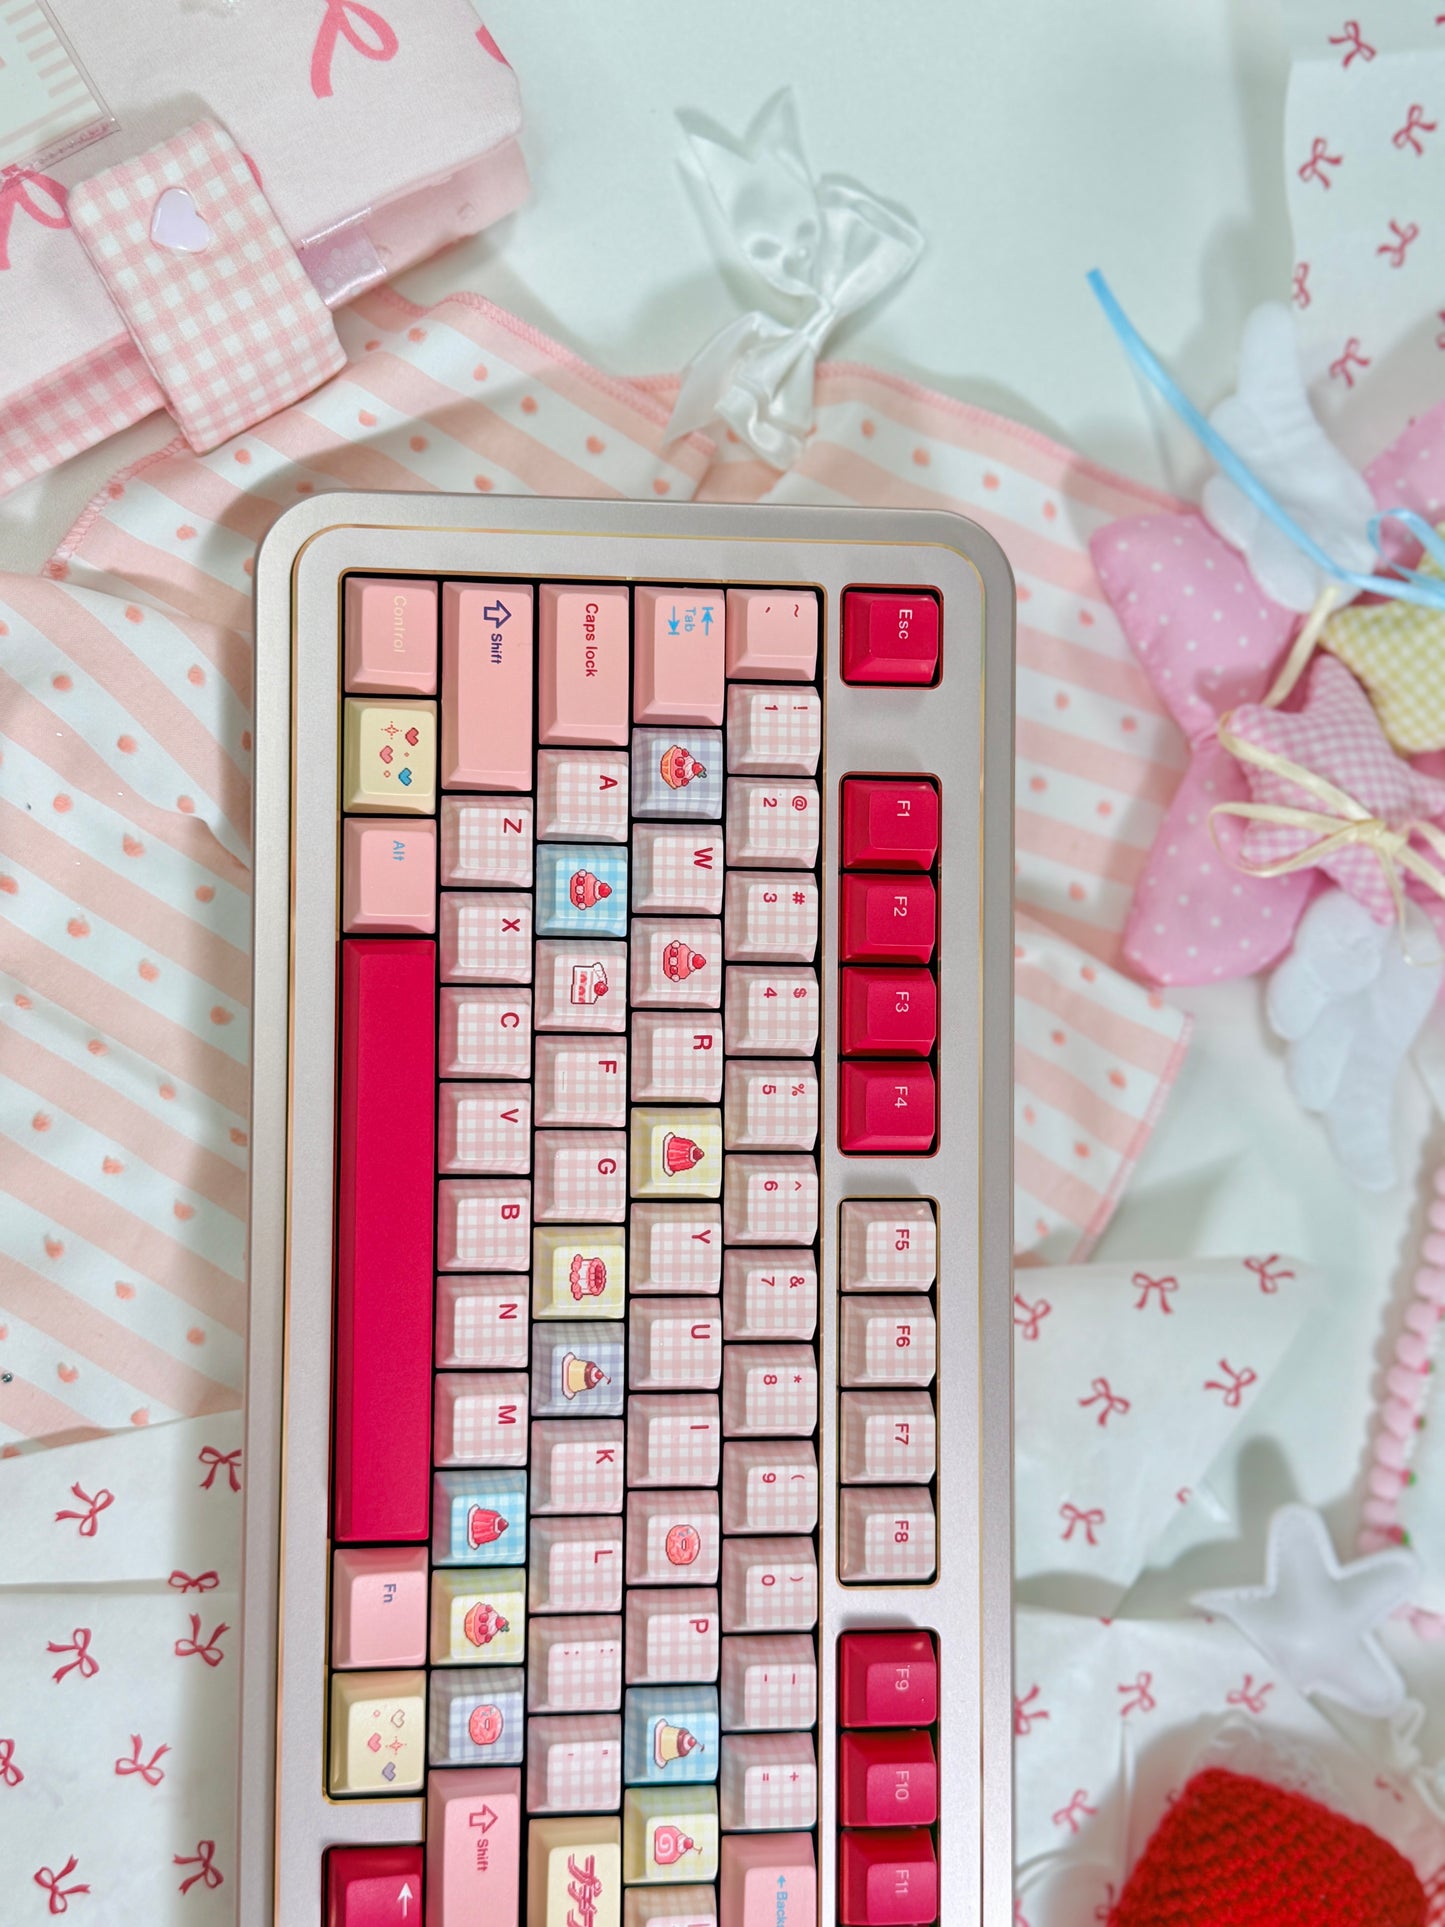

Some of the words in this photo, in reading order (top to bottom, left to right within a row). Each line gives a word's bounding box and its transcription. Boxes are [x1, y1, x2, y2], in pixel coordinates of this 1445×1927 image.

[393, 595, 408, 654] Control
[584, 602, 599, 642] Caps
[683, 606, 697, 633] Tab
[898, 609, 913, 640] Esc
[490, 633, 503, 665] Shift
[585, 646, 599, 677] lock
[599, 774, 619, 791] A
[763, 797, 778, 808] 2
[791, 795, 808, 812] @
[896, 800, 911, 817] F1
[503, 817, 523, 834] Z
[392, 839, 406, 862] Alt
[693, 846, 714, 870] W
[762, 892, 778, 904] 3
[792, 891, 806, 906] #
[893, 896, 908, 917] F2
[501, 918, 521, 933] X
[763, 986, 778, 999] 4
[792, 987, 808, 999] $
[895, 991, 910, 1013] F3
[500, 1011, 520, 1029] C
[692, 1034, 713, 1051] R
[597, 1060, 618, 1075] F
[762, 1084, 777, 1096] 5
[791, 1083, 806, 1097] %
[894, 1086, 908, 1109] F4
[499, 1108, 520, 1124] V
[597, 1157, 617, 1175] G
[763, 1180, 779, 1192] 6
[500, 1204, 521, 1220] B
[691, 1229, 712, 1245] Y
[894, 1228, 910, 1252] F5
[760, 1276, 776, 1287] 7
[789, 1275, 806, 1289] &
[498, 1303, 518, 1320] N
[690, 1323, 711, 1340] U
[895, 1325, 911, 1348] F6
[762, 1374, 778, 1386] 8
[497, 1404, 518, 1425] M
[894, 1423, 910, 1446] F7
[595, 1449, 615, 1465] K
[762, 1472, 777, 1484] 9
[894, 1520, 910, 1544] F8
[593, 1549, 614, 1564] L
[383, 1583, 397, 1604] Fn
[689, 1618, 710, 1634] P
[895, 1667, 911, 1691] F9
[789, 1771, 800, 1783] +
[895, 1770, 910, 1801] F10
[476, 1838, 489, 1872] Shift
[895, 1869, 910, 1894] F11
